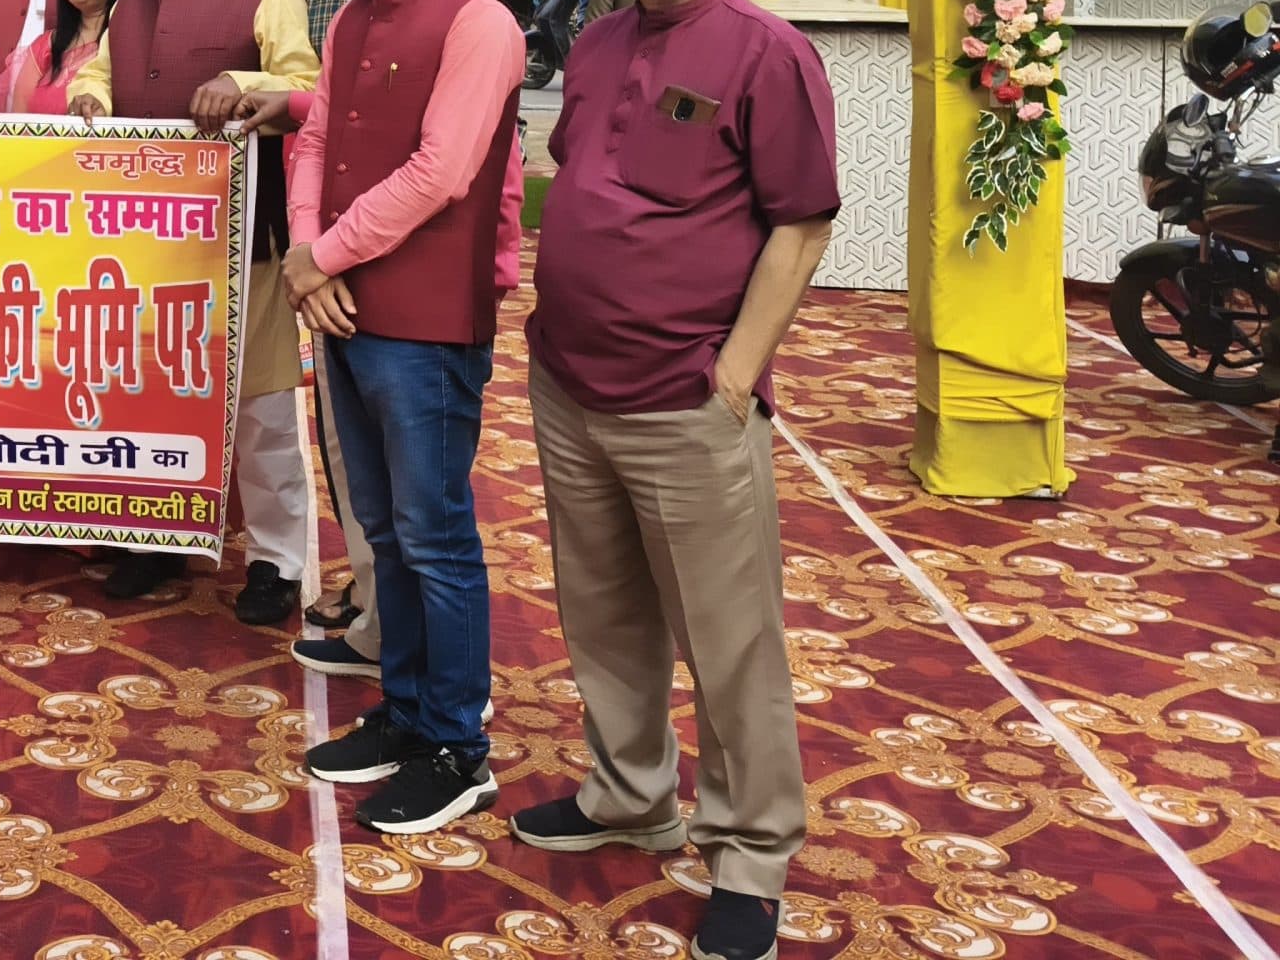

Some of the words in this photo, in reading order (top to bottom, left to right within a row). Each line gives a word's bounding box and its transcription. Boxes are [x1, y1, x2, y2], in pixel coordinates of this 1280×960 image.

[75, 146, 184, 178] समृद्धि
[12, 191, 71, 233] का
[84, 193, 218, 238] सम्मान
[55, 258, 140, 421] भूमि
[152, 282, 210, 388] पर
[80, 436, 140, 469] जी
[151, 449, 188, 469] का
[17, 483, 51, 513] एवं
[54, 490, 124, 516] स्वागत
[128, 491, 187, 521] करती
